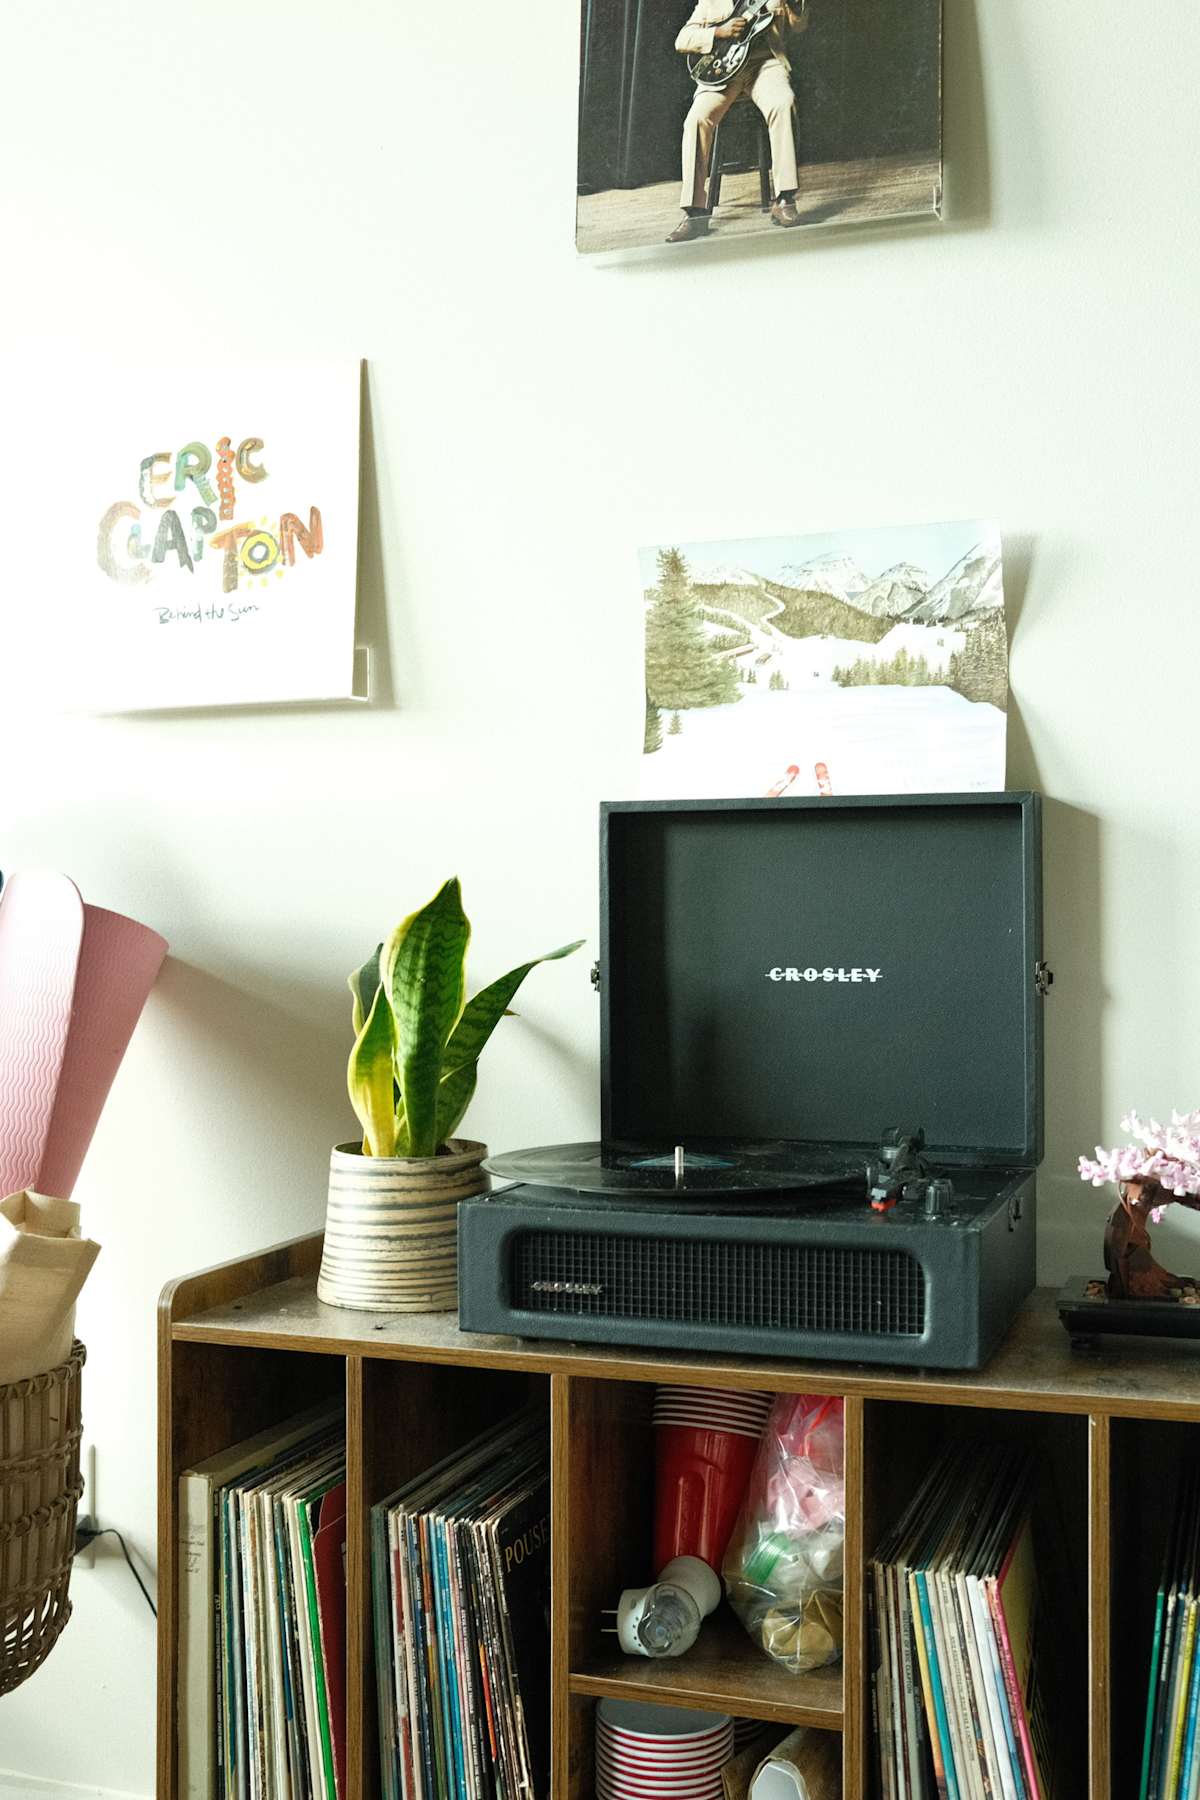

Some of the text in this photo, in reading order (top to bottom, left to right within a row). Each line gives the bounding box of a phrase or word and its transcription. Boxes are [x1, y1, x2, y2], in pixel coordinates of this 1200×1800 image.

[139, 436, 270, 520] ERIC
[97, 501, 324, 593] CLAPTON
[153, 601, 260, 624] Behind the Sun
[765, 967, 883, 983] CROSLEY
